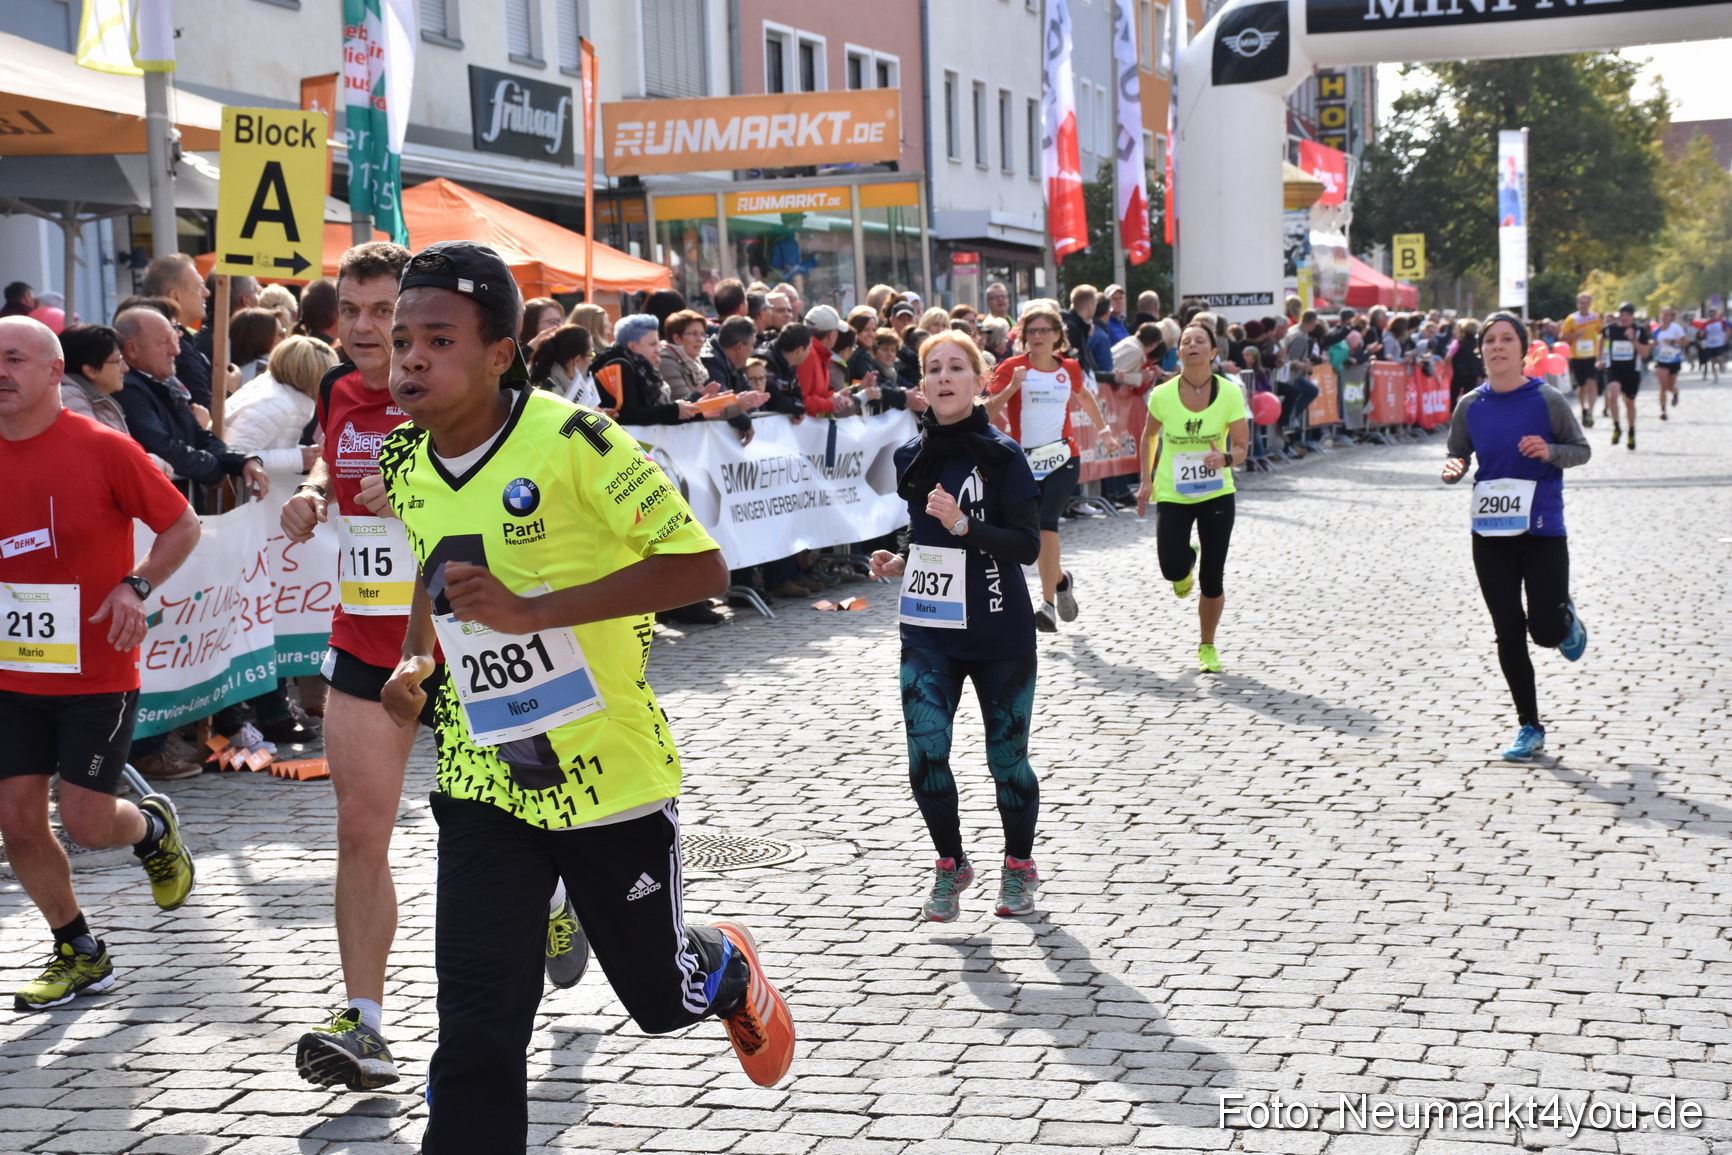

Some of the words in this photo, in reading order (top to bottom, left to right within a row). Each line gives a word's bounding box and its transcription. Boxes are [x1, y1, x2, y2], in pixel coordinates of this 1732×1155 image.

[235, 114, 316, 148] Block
[240, 160, 301, 242] A
[737, 192, 841, 212] RUNMARKT.DE
[1402, 248, 1416, 269] B
[1033, 454, 1065, 471] 2769
[605, 457, 645, 495] zerbock
[721, 461, 759, 494] BMW
[505, 479, 536, 493] BMW
[1479, 495, 1521, 514] 2904
[503, 518, 545, 537] Partl
[667, 512, 683, 526] NEXT
[505, 533, 546, 545] Neumarkt
[659, 523, 680, 539] YEARS
[14, 537, 36, 550] DEHN
[350, 547, 393, 577] 115
[358, 588, 380, 598] Peter
[908, 570, 954, 597] 2037
[916, 603, 937, 613] Maria
[6, 611, 55, 638] 213
[18, 647, 44, 658] Mario
[462, 633, 555, 694] 2681
[507, 698, 539, 716] Nico
[88, 754, 101, 776] GORE
[627, 881, 662, 902] adidas
